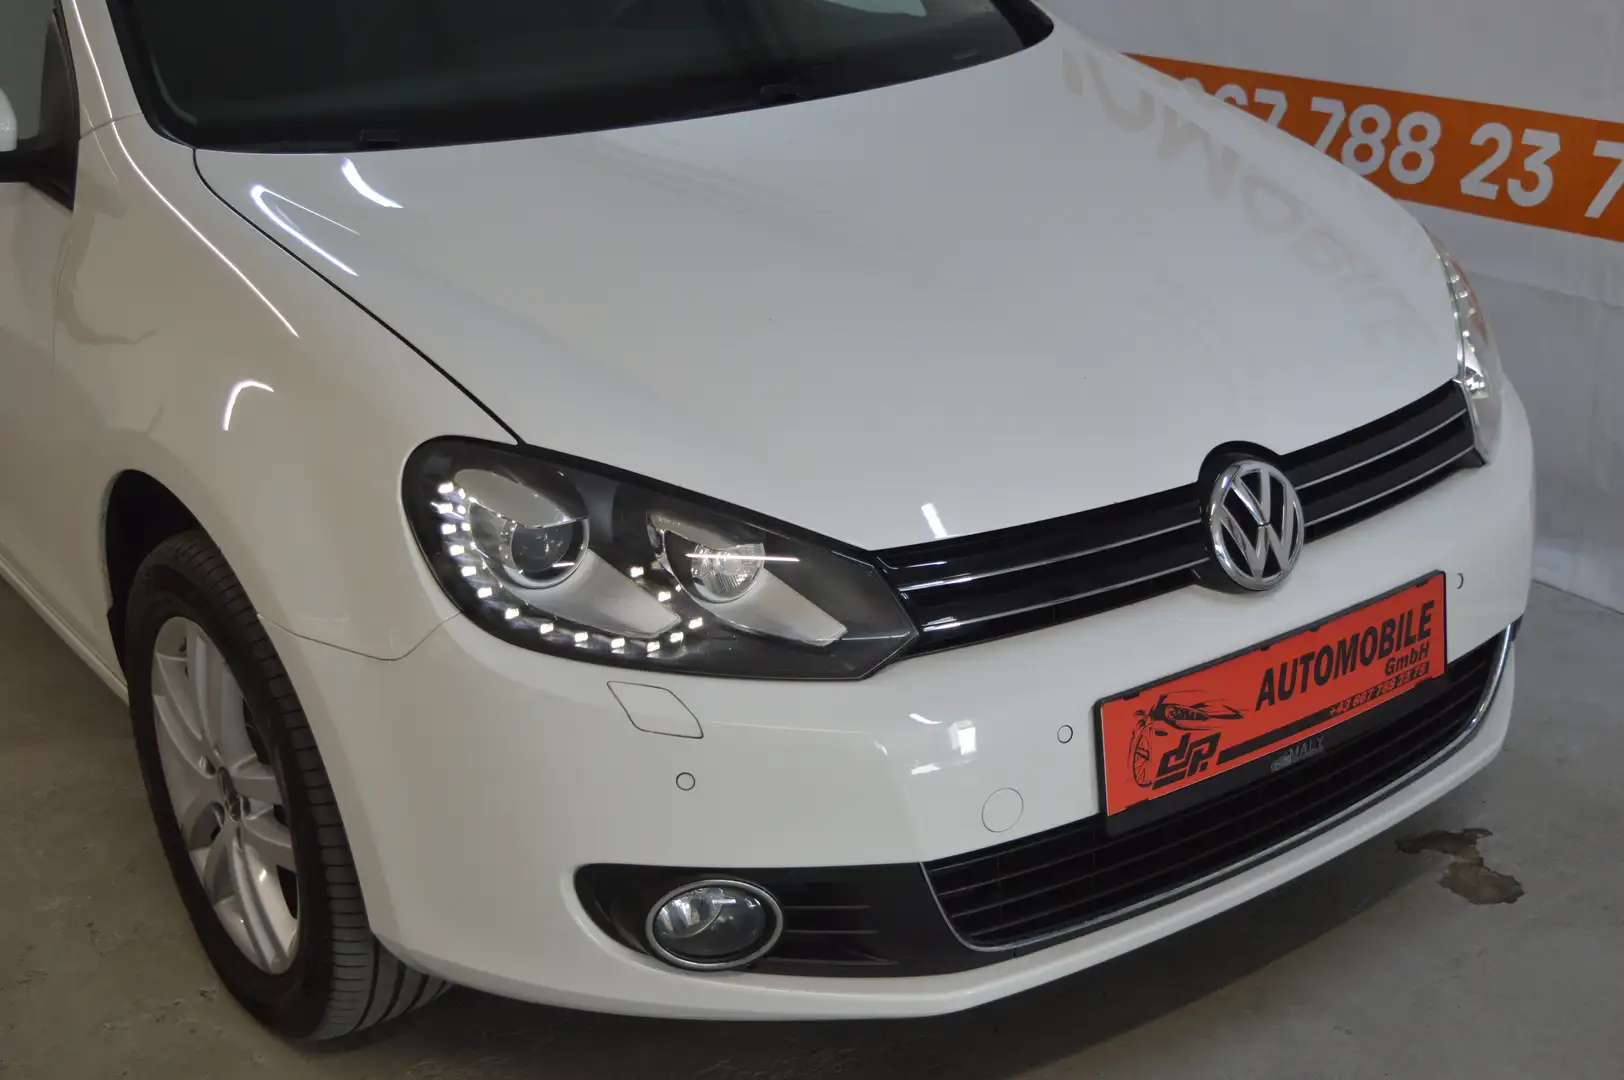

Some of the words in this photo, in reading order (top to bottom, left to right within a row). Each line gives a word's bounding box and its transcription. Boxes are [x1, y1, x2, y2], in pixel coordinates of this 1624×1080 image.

[1310, 96, 1442, 185] 788
[1459, 122, 1562, 208] 23
[1255, 600, 1435, 712] AUTOMOBILE
[1385, 641, 1430, 676] GmbH
